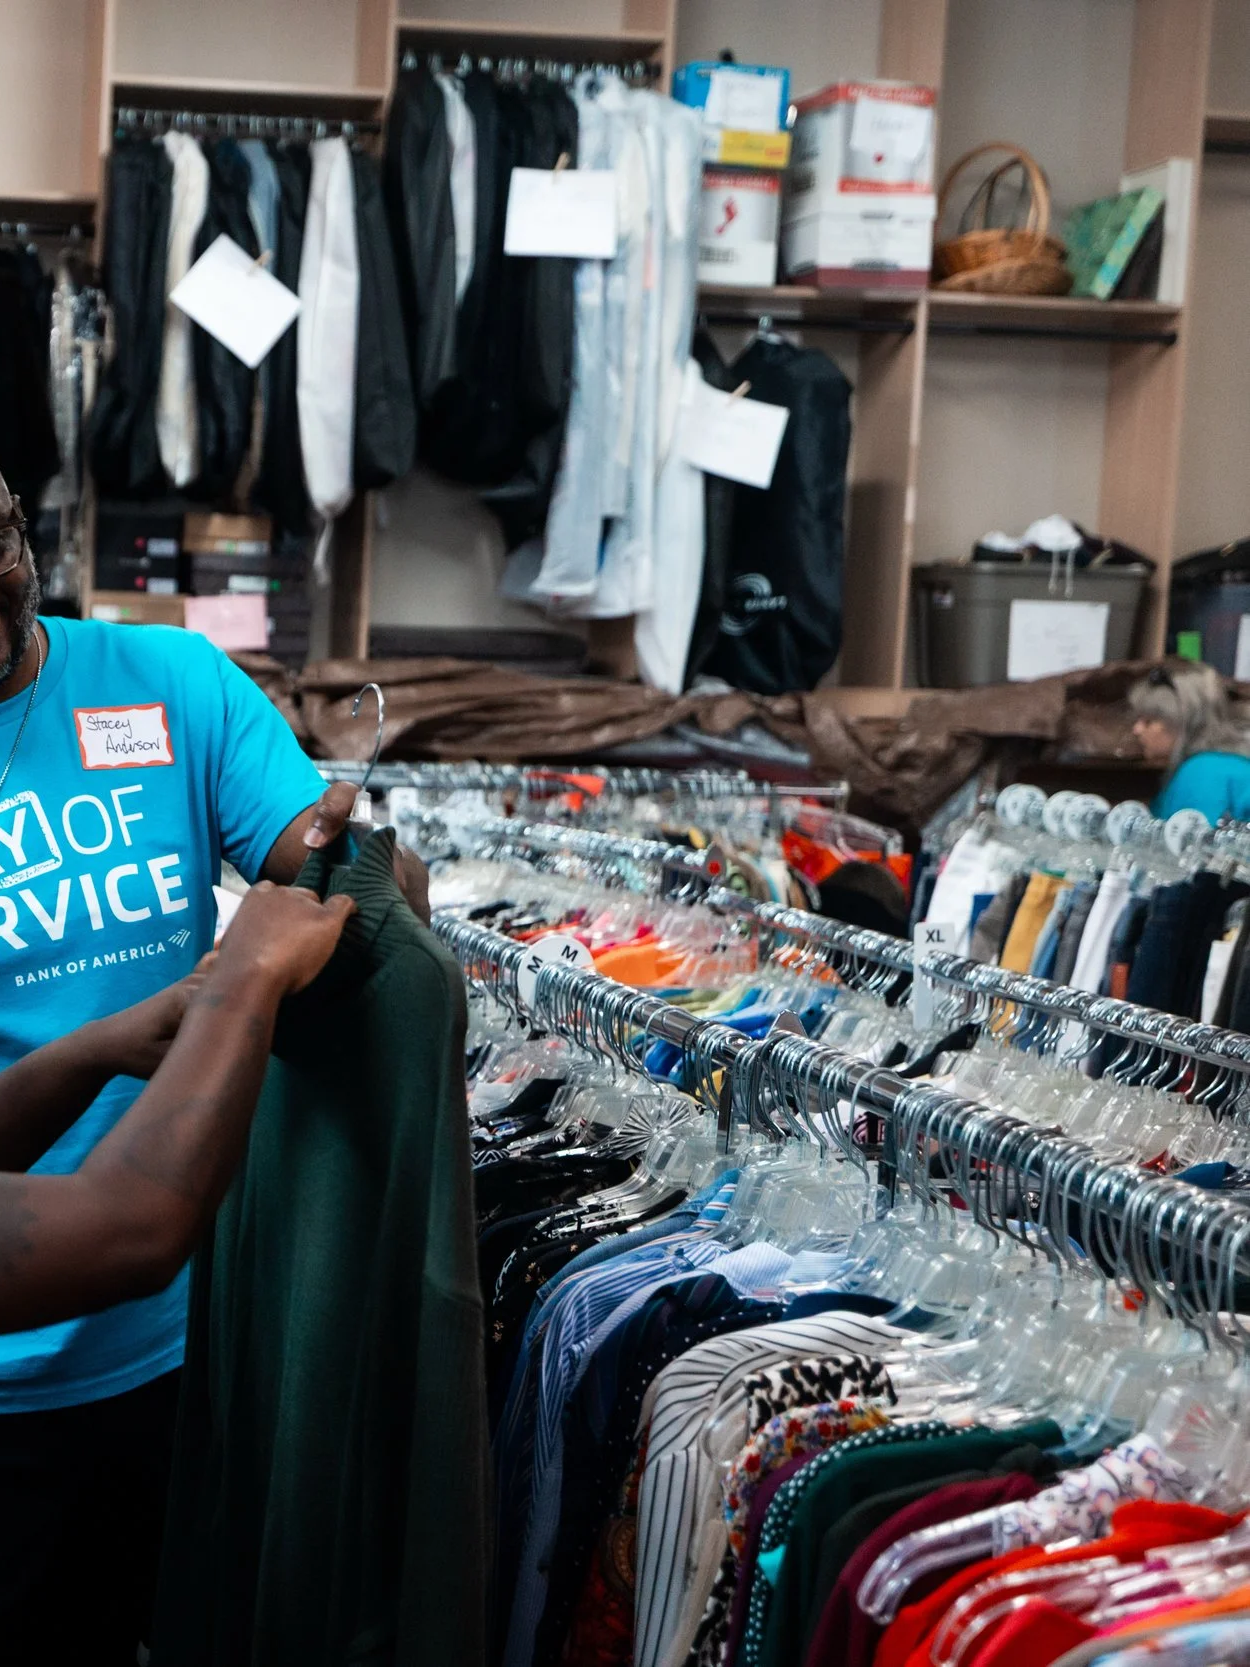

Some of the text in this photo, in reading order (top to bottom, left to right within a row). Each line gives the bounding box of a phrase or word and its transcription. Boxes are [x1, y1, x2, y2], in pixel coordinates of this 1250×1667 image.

[86, 715, 133, 739] Stacey
[106, 734, 160, 754] Anderson
[61, 784, 144, 855] OF
[925, 929, 946, 943] XL
[561, 944, 579, 962] M
[15, 941, 166, 987] BANK OF AMERICA
[526, 955, 543, 974] M
